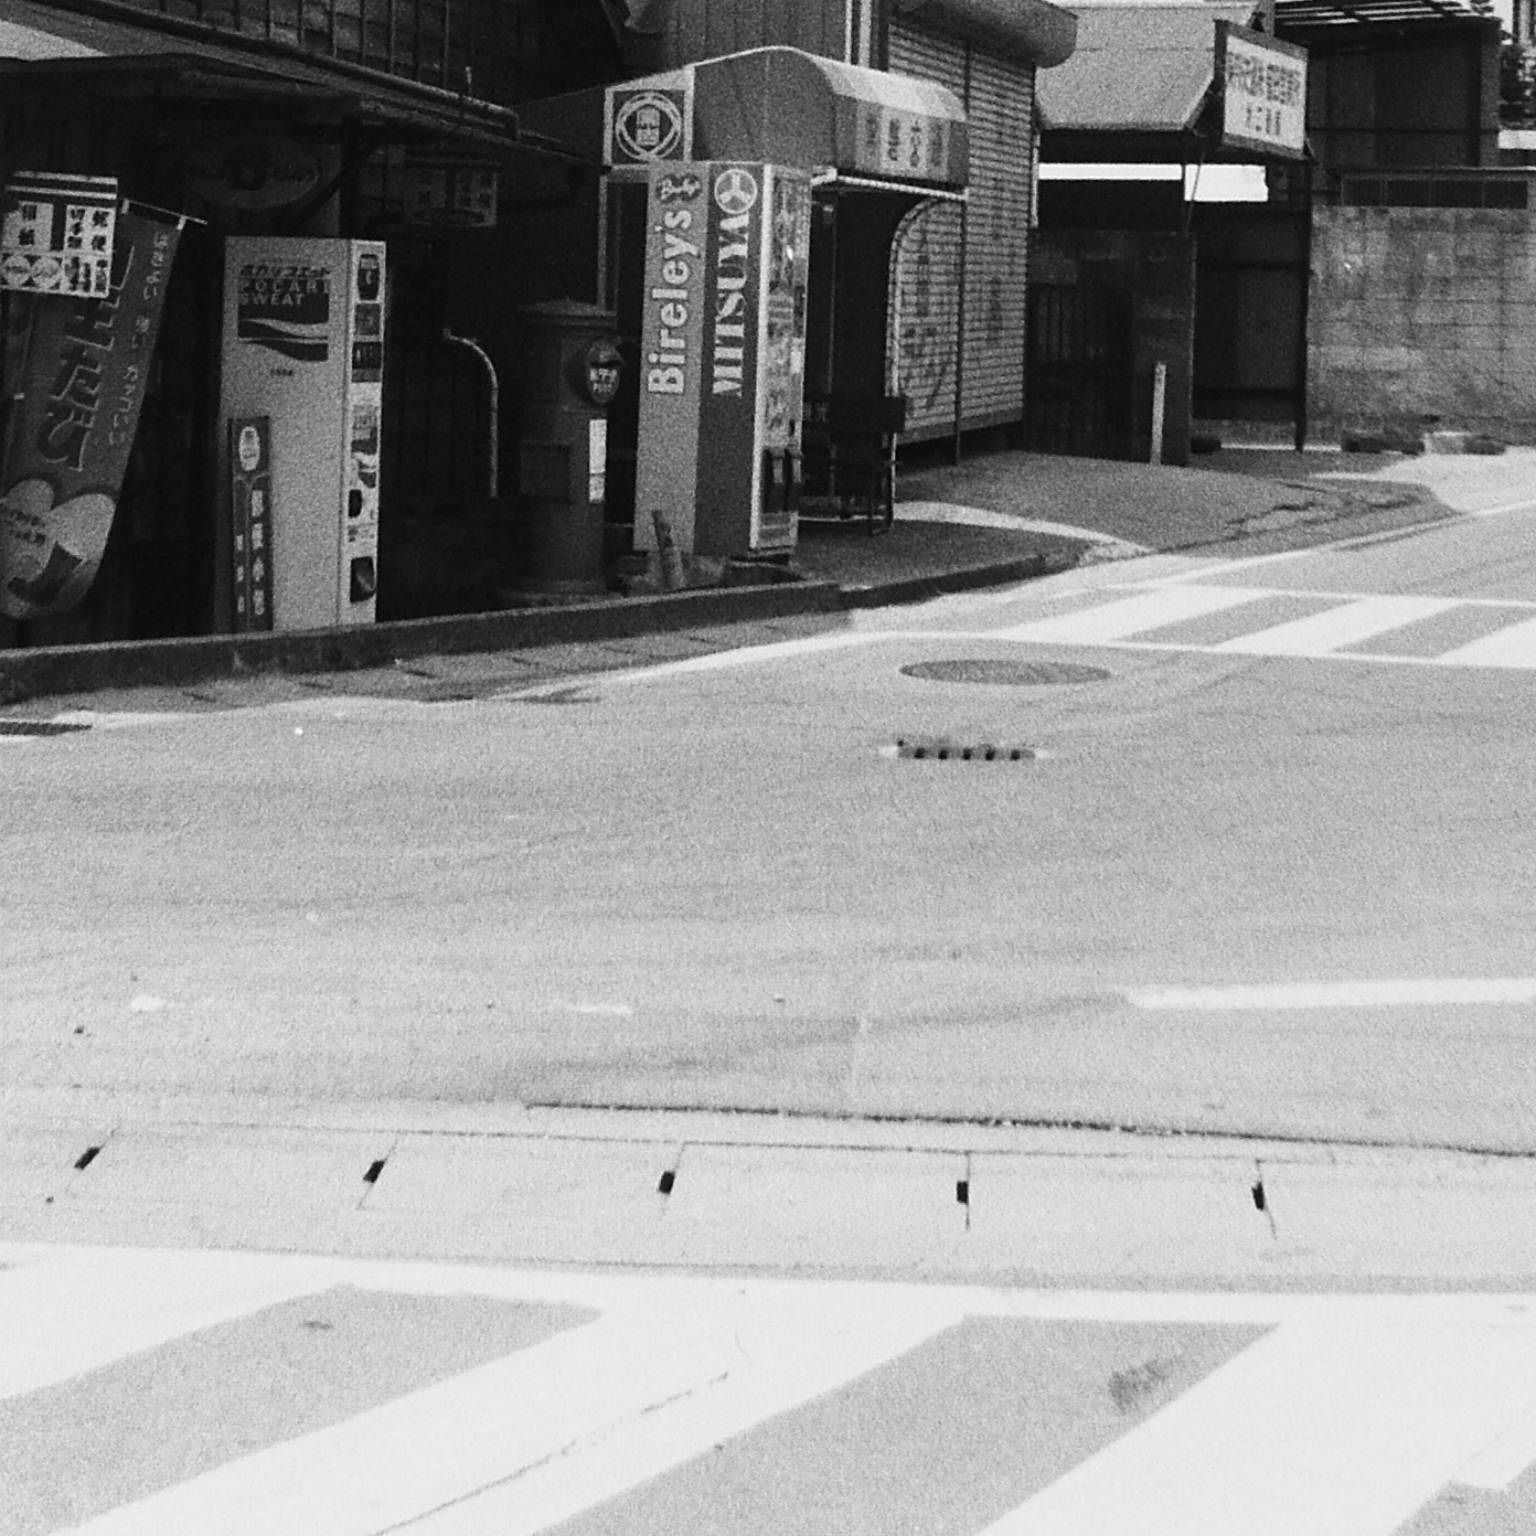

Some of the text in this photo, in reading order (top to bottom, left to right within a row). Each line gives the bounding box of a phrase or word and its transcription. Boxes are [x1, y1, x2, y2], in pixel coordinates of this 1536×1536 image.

[239, 279, 329, 294] POCARI
[240, 292, 305, 306] SWEAT
[647, 208, 700, 394] Bireley's
[712, 210, 751, 399] MITSUYA
